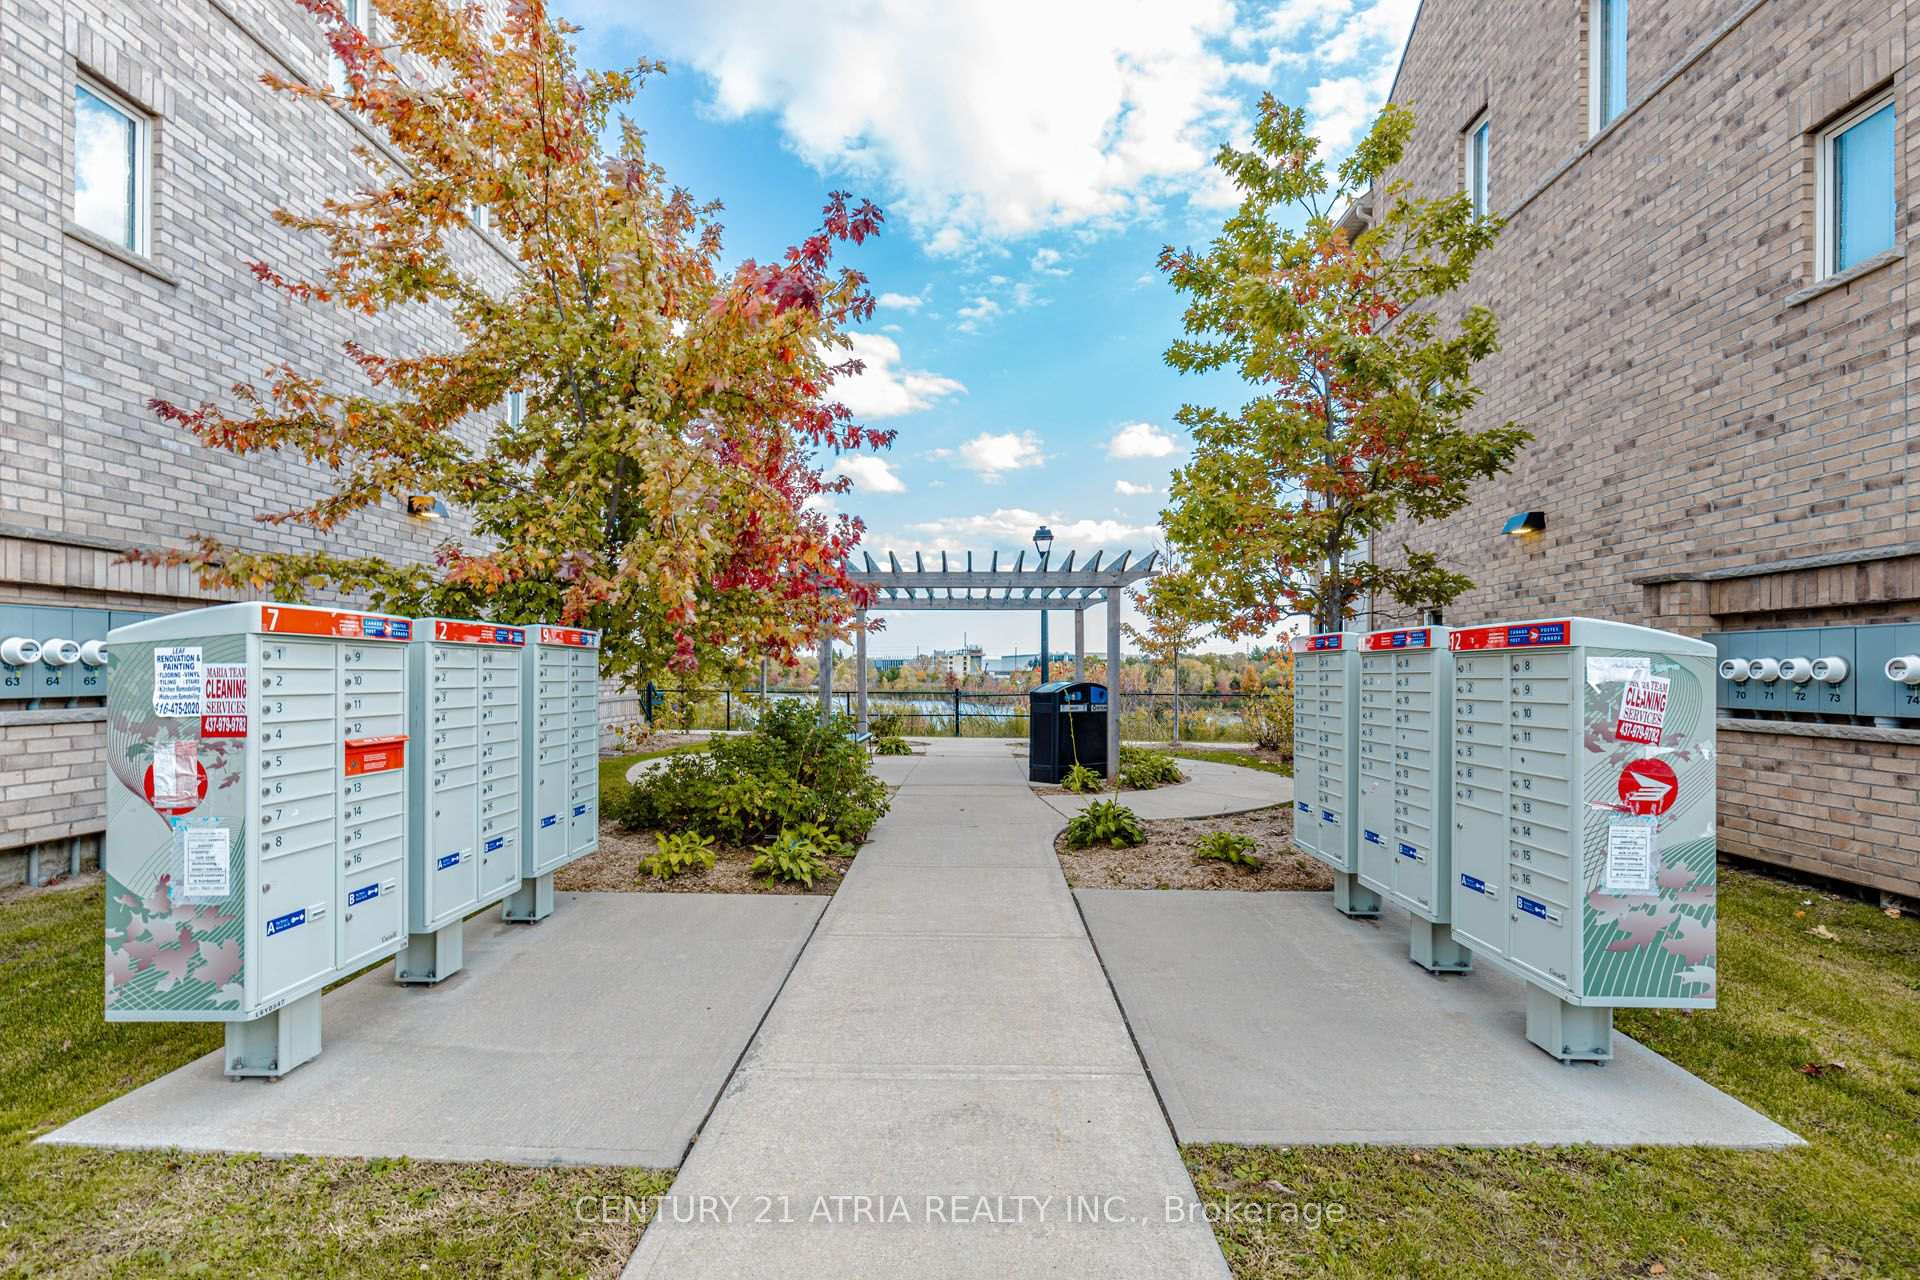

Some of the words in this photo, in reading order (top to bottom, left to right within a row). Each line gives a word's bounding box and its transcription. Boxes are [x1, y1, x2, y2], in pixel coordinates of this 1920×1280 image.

[267, 608, 279, 632] 7
[440, 622, 447, 639] 2
[543, 628, 549, 642] 9
[1450, 633, 1461, 650] 12
[355, 652, 361, 661] 9
[1525, 661, 1530, 670] 8
[207, 667, 227, 678] MARIA
[229, 667, 247, 677] TEAM
[5, 677, 20, 686] 63
[46, 677, 60, 686] 64
[83, 677, 96, 685] 65
[276, 675, 283, 686] 2
[354, 676, 362, 685] 10
[205, 679, 247, 699] CLEANING
[1525, 684, 1530, 694] 9
[1626, 687, 1667, 712] CLEANING
[1736, 690, 1746, 699] 70
[1763, 691, 1774, 700] 71
[1795, 692, 1806, 701] 72
[1829, 693, 1840, 703] 73
[1906, 695, 1920, 704] 74
[206, 701, 246, 713] SERVICES
[276, 702, 283, 713] 3
[354, 699, 361, 709] 11
[1524, 708, 1531, 718] 10
[1624, 708, 1662, 724] SERVICES
[354, 723, 361, 733] 12
[275, 728, 282, 739] 4
[1524, 732, 1531, 741] 11
[276, 756, 282, 767] 5
[275, 783, 282, 793] 6
[353, 783, 361, 792] 13
[1523, 780, 1531, 789] 12
[353, 807, 361, 816] 14
[1523, 803, 1531, 813] 13
[275, 809, 282, 820] 7
[353, 830, 362, 840] 15
[1523, 826, 1531, 836] 14
[275, 836, 282, 847] 8
[353, 853, 362, 864] 16
[1523, 850, 1531, 860] 15
[1523, 874, 1531, 884] 16
[267, 922, 275, 935] A
